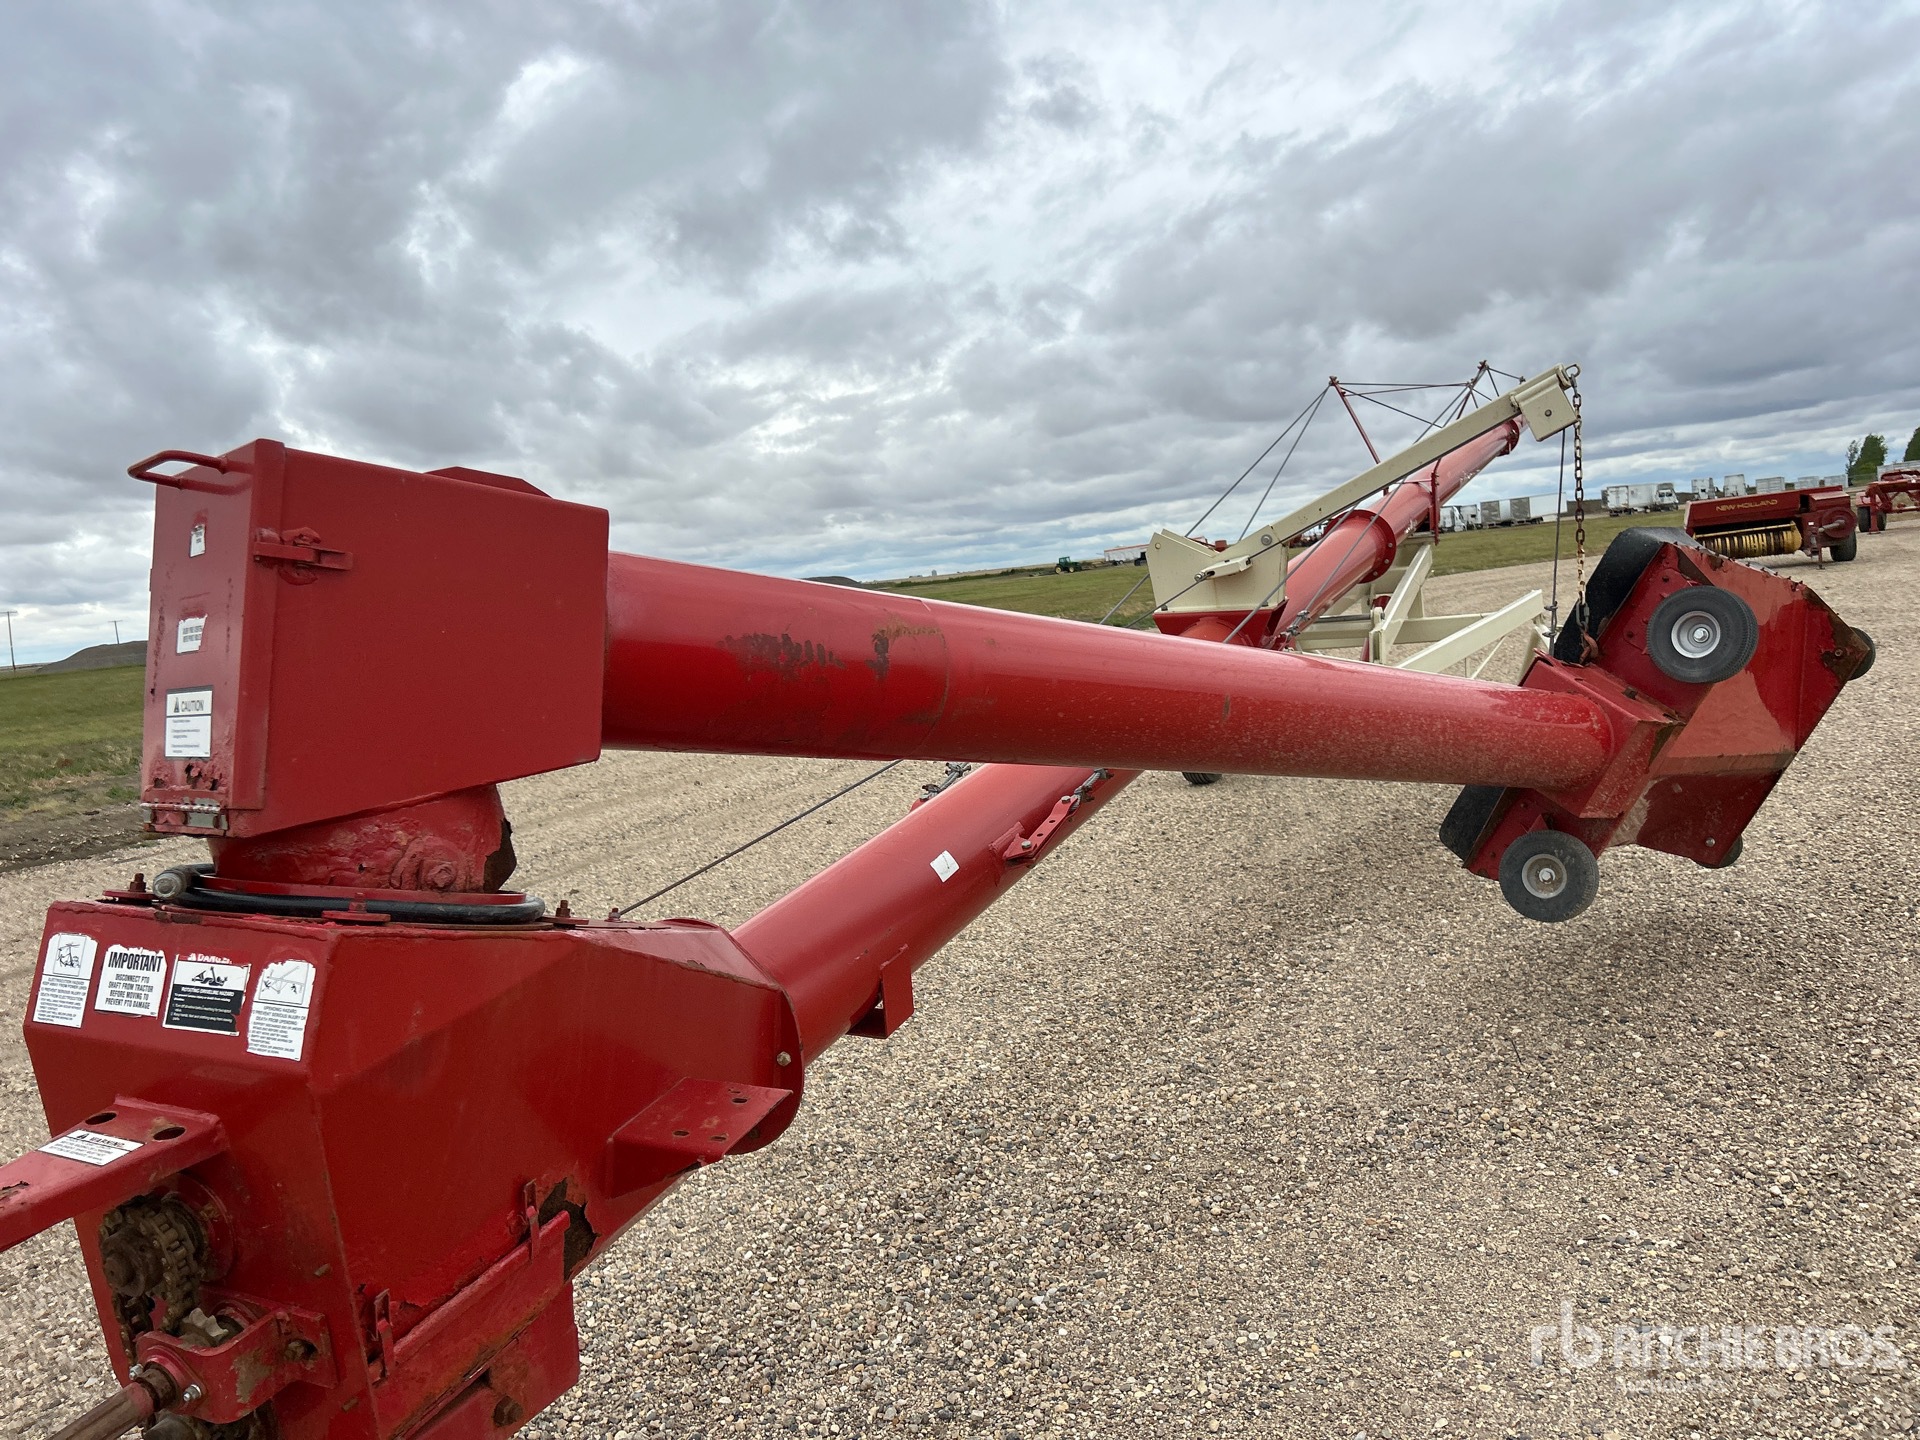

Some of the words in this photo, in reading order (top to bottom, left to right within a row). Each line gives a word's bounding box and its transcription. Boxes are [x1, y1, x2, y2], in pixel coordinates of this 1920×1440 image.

[1716, 504, 1736, 512] NEW
[1737, 499, 1778, 509] HOLLAND
[181, 700, 205, 712] CAUTION
[108, 951, 164, 972] IMPORTANT
[115, 973, 141, 982] DISCONNECT
[141, 976, 150, 984] PTO
[108, 981, 122, 989] SHAFT
[122, 982, 134, 991] FROM
[134, 984, 154, 993] TRACTOR
[109, 990, 126, 998] BEFORE
[126, 991, 143, 1000] MOVING
[143, 993, 150, 1001] TO
[105, 998, 124, 1006] PREVENT
[123, 999, 133, 1008] PTO
[132, 1000, 151, 1010] DAMAGE
